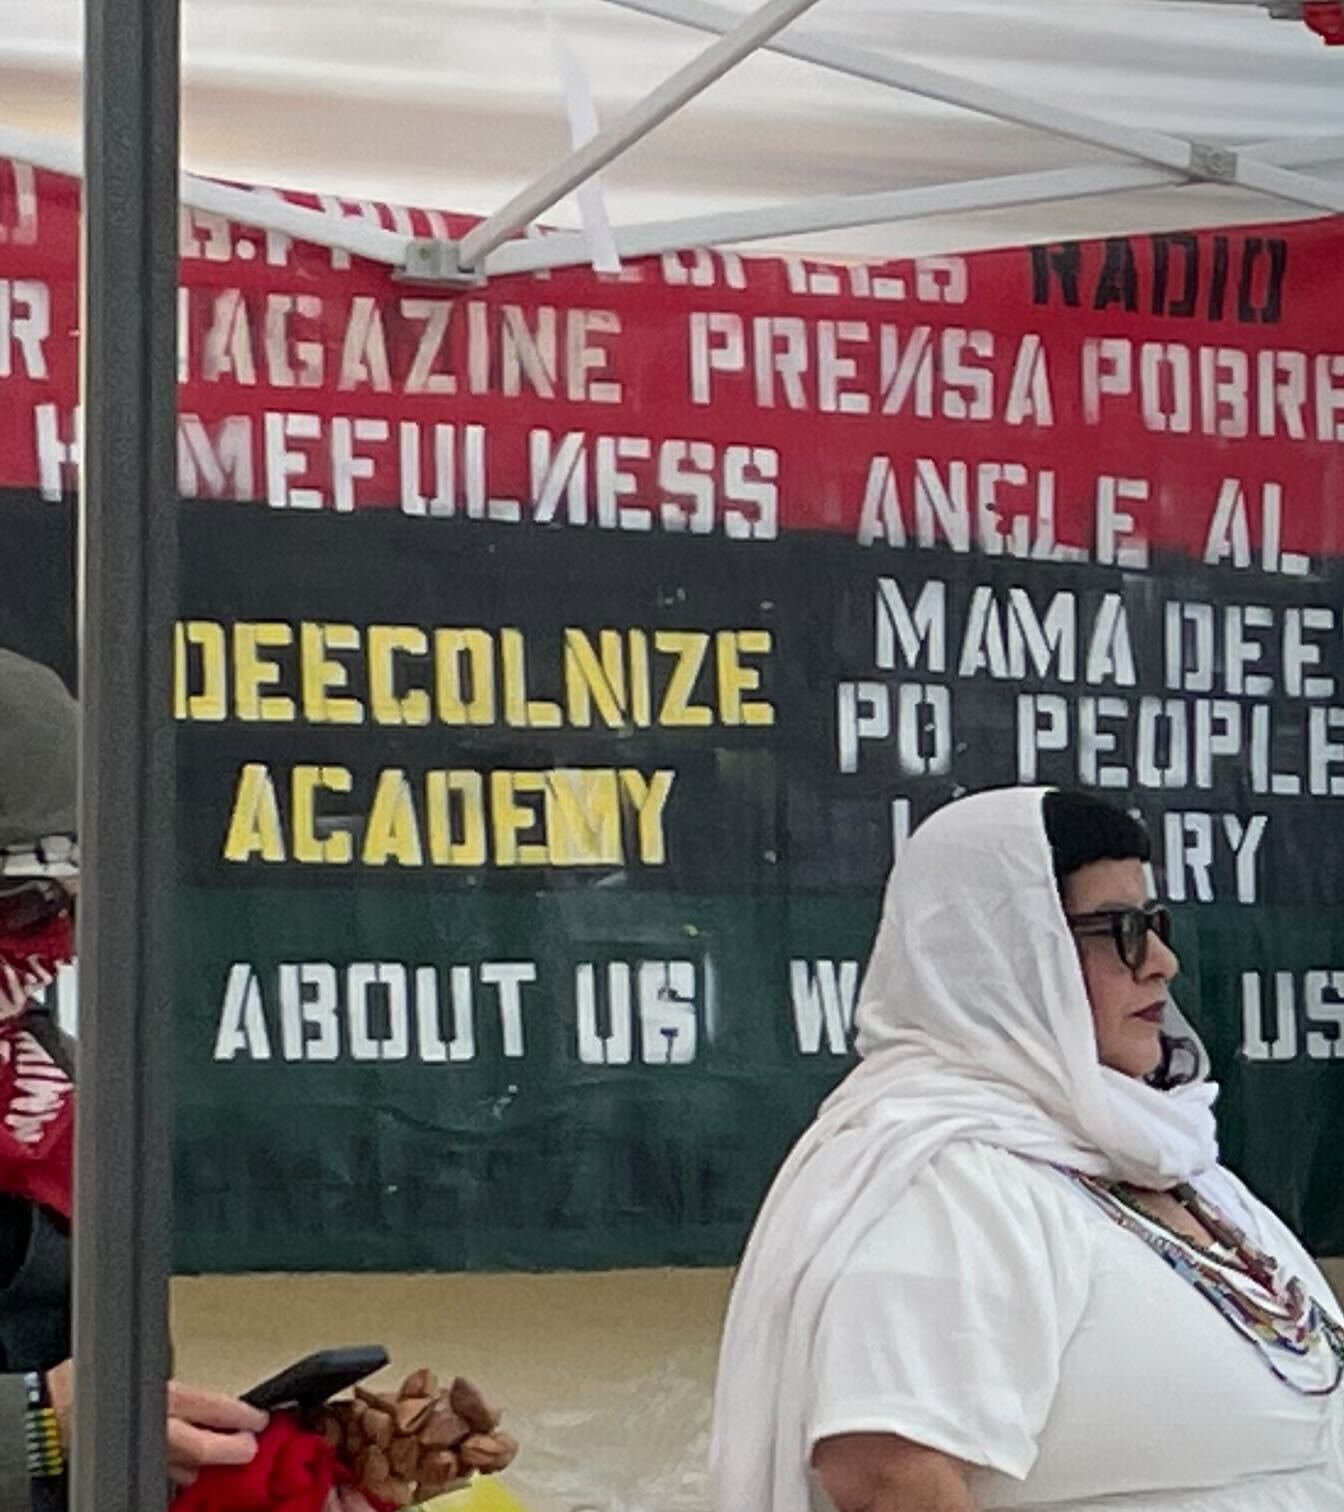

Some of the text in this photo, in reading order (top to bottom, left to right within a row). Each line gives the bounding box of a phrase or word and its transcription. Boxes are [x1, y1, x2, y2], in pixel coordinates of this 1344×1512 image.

[1028, 236, 1288, 324] RADIO
[35, 403, 778, 540] HMEFULNESS
[1203, 478, 1311, 575] AL
[174, 620, 776, 728] DEECOLNIZE
[875, 577, 1336, 698] MAMA DEE
[837, 682, 953, 775] PO
[223, 763, 676, 867] ACADEMY
[213, 963, 537, 1064] ABOUT
[575, 960, 698, 1065] US
